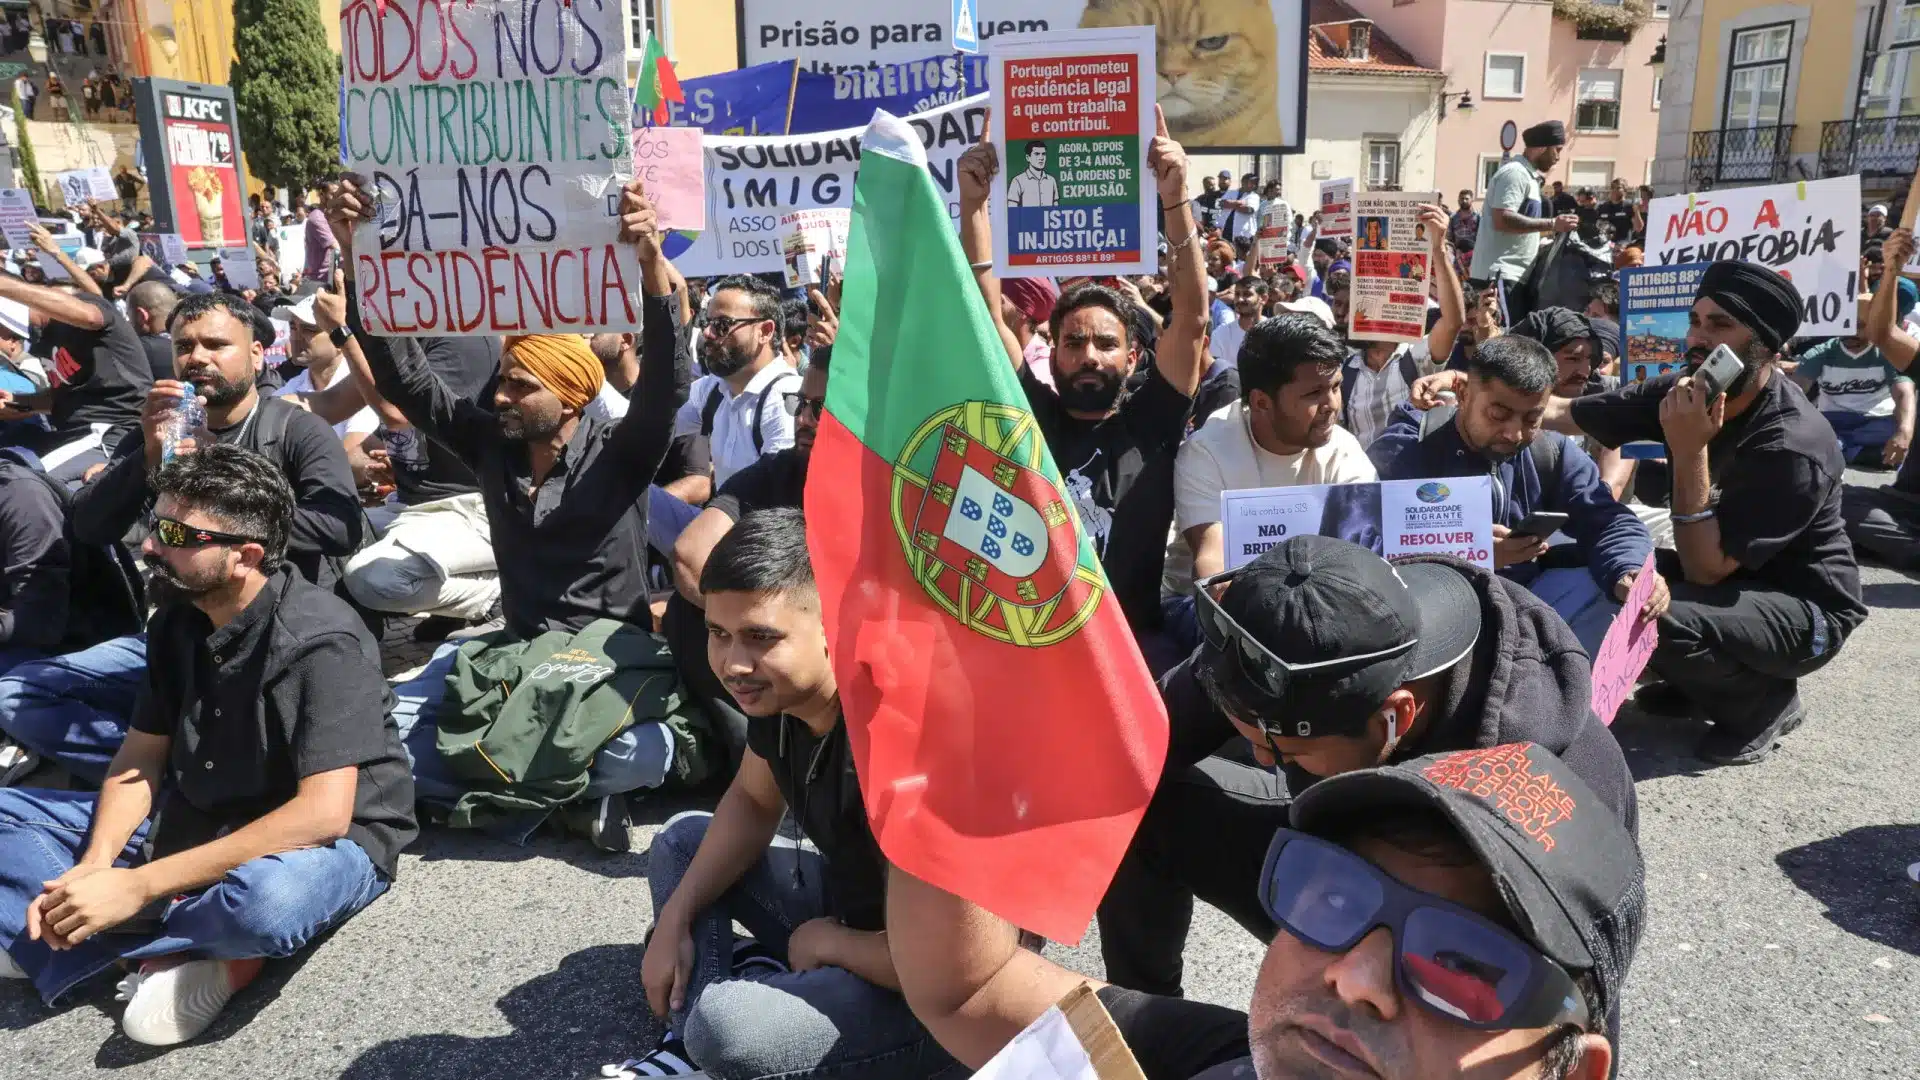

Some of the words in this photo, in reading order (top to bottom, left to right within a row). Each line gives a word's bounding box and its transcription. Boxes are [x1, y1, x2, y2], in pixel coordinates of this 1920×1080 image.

[340, 0, 477, 83] TODOS
[495, 0, 602, 78] NOS
[760, 20, 860, 48] Prisão
[870, 20, 942, 49] para
[977, 17, 1049, 40] uem
[834, 57, 959, 100] DIREITOS
[1010, 62, 1064, 80] Portugal
[1066, 61, 1129, 79] prometeu
[1011, 80, 1090, 98] residência
[1094, 77, 1131, 96] legal
[183, 98, 223, 121] KFC
[1012, 105, 1021, 117] a
[1025, 102, 1063, 119] quem
[1068, 98, 1126, 115] trabalha
[347, 76, 625, 166] CONTRIBUINTES
[1031, 121, 1040, 133] e
[1043, 116, 1111, 133] contribui.
[1058, 143, 1091, 154] AGORA,
[1092, 141, 1124, 152] DEPOIS
[1059, 156, 1073, 168] DE
[1074, 155, 1092, 168] 3-4
[1094, 154, 1125, 168] ANOS,
[1059, 168, 1074, 182] DÁ
[1076, 169, 1116, 181] ORDENS
[1118, 168, 1132, 180] DE
[1063, 181, 1128, 198] EXPULSÃO.
[373, 165, 557, 250] DÁ-NOS
[1373, 198, 1384, 208] NÃO
[1043, 209, 1087, 229] ISTO
[1093, 206, 1104, 228] É
[1664, 201, 1729, 244] NÃO
[1752, 199, 1781, 231] A
[732, 240, 769, 259] DOS
[1018, 229, 1126, 251] INJUSTIÇA!
[1036, 254, 1074, 264] ARTIGOS
[1093, 253, 1098, 262] E
[359, 244, 636, 333] RESIDÊNCIA
[1628, 272, 1677, 286] ARTIGOS
[1628, 286, 1676, 297] TRABALHAR
[1677, 284, 1690, 295] EM
[1628, 299, 1632, 309] É
[1633, 298, 1657, 309] DIREITO
[1658, 298, 1674, 307] PARA
[1240, 506, 1257, 517] luta
[1260, 506, 1285, 516] contra
[1405, 505, 1462, 514] SOLIDARIEDADE
[1405, 512, 1462, 521] IMIGRANTE
[1400, 532, 1474, 546] RESOLVER
[1243, 542, 1282, 556] BRIN
[1478, 757, 1572, 820] FORGET
[1497, 796, 1556, 852] TOUR
